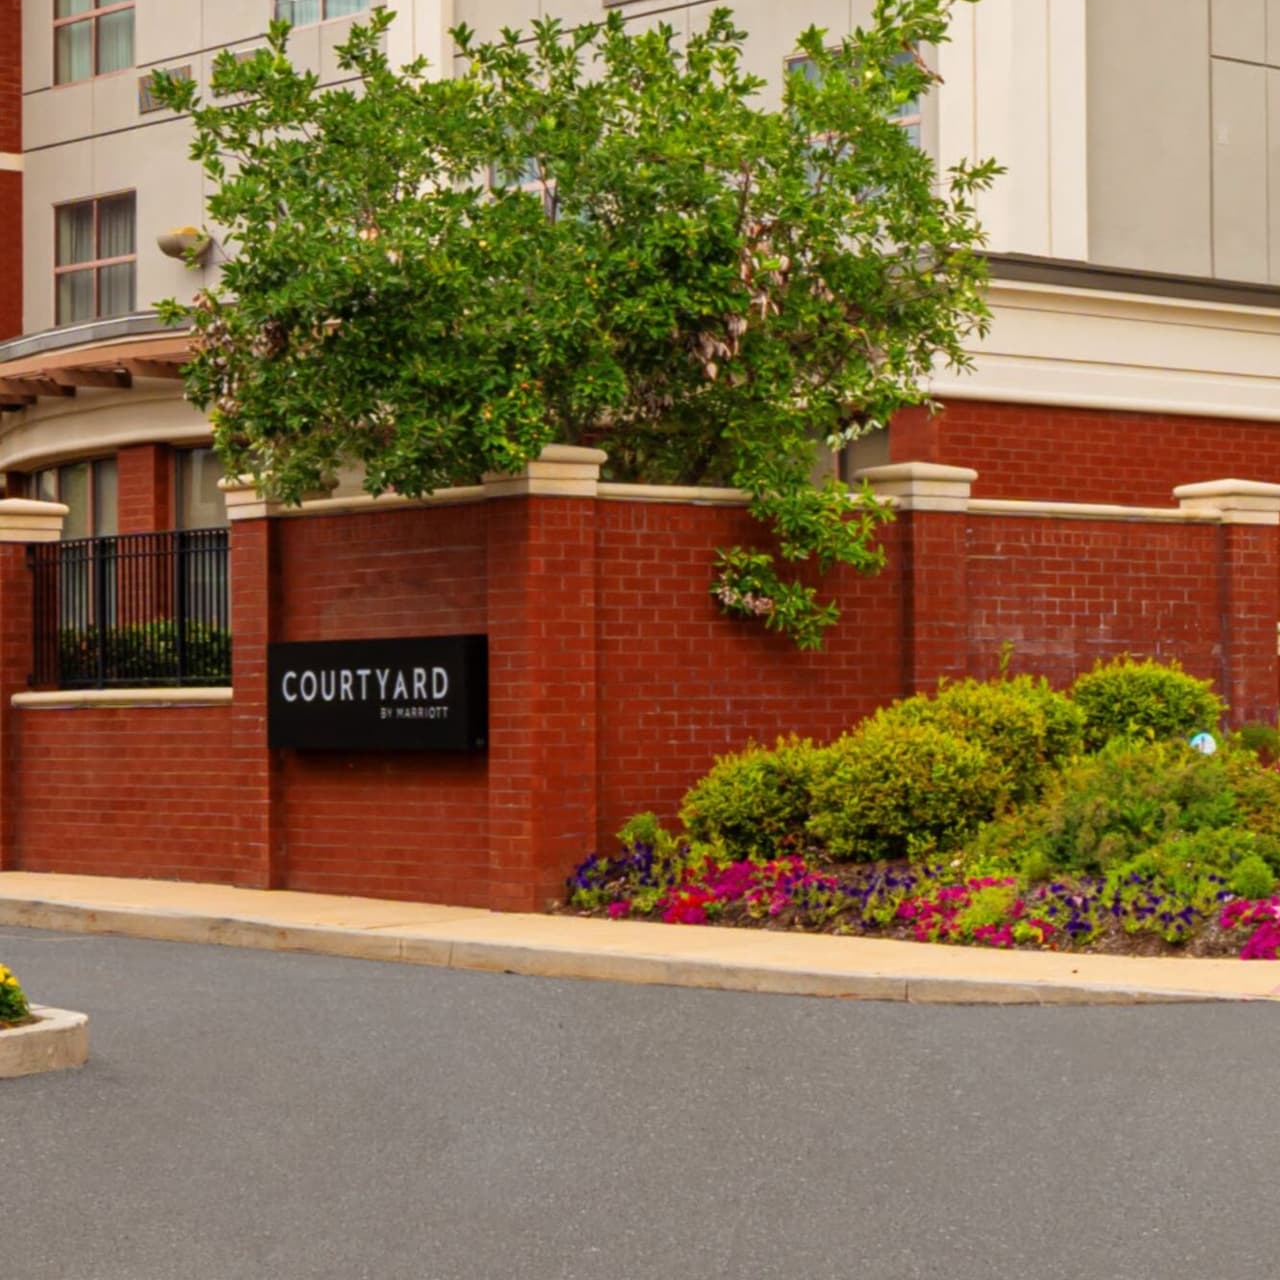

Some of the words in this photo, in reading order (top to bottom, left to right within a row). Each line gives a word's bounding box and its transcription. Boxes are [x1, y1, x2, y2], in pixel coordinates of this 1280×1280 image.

[282, 667, 448, 702] COURTYARD
[379, 706, 393, 720] BY
[396, 706, 449, 720] MARRIOTT
